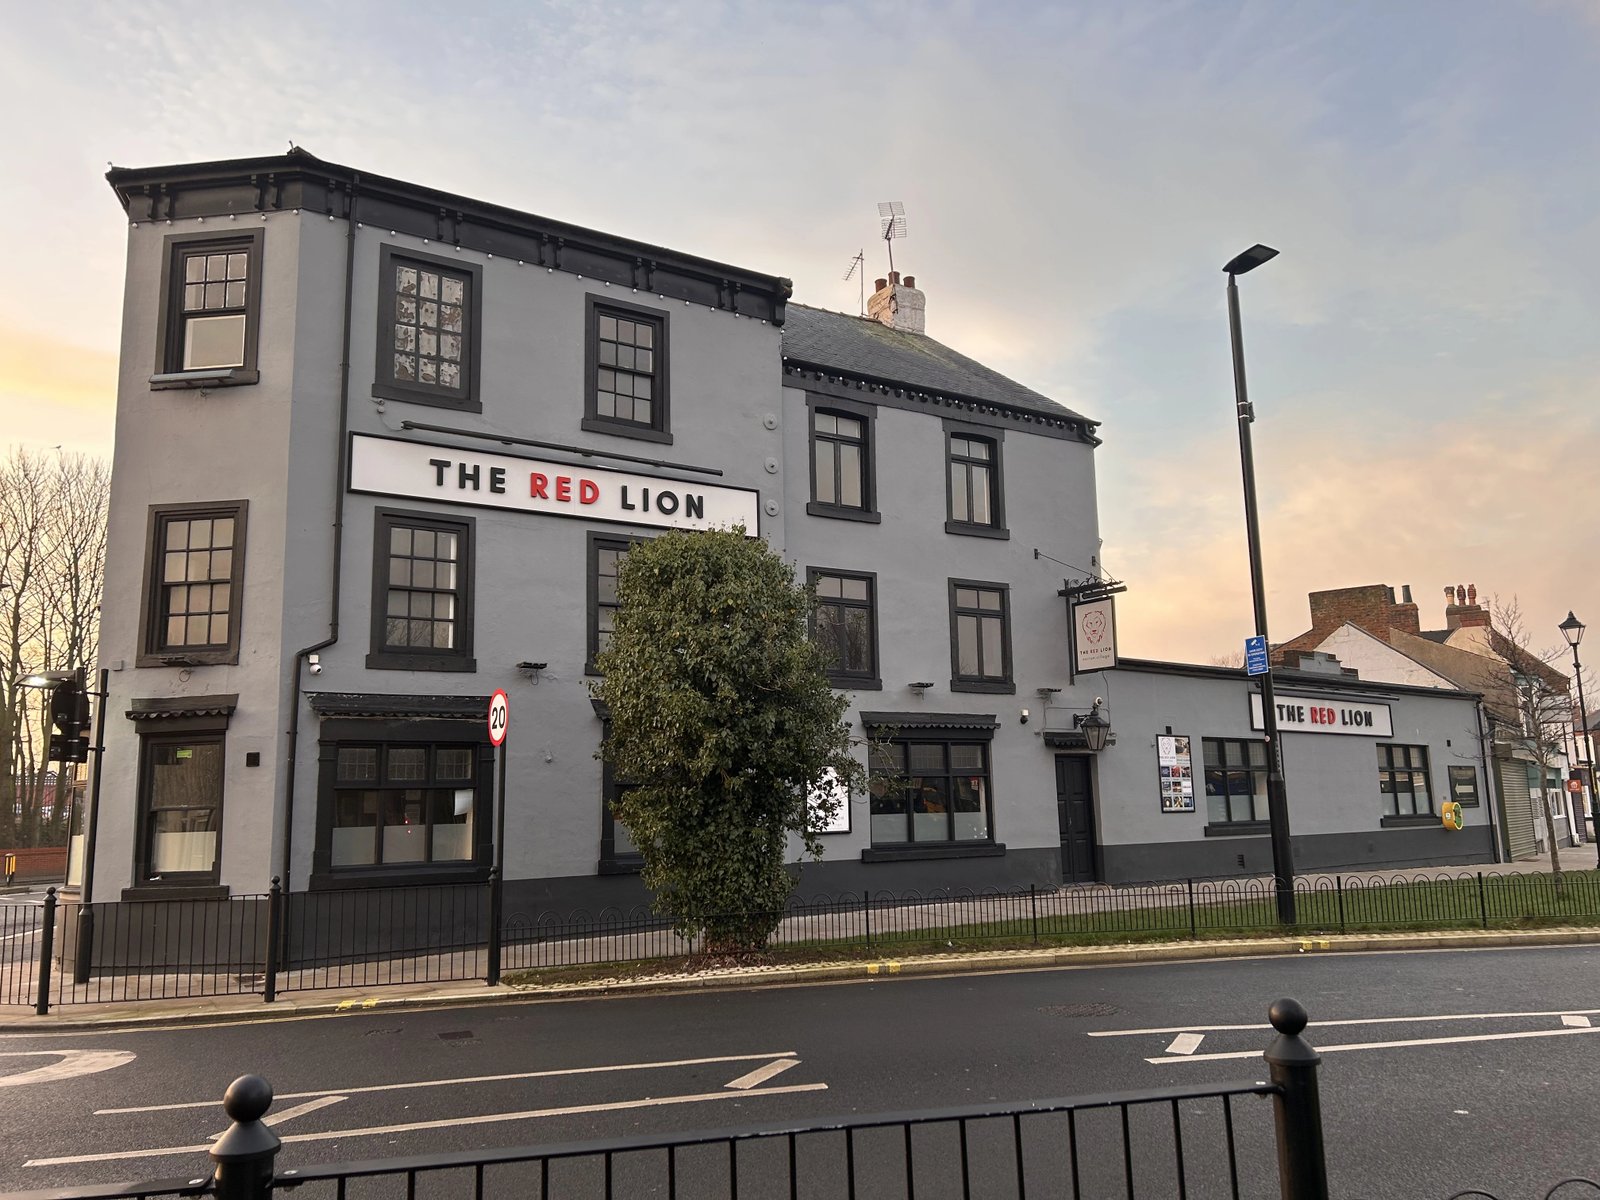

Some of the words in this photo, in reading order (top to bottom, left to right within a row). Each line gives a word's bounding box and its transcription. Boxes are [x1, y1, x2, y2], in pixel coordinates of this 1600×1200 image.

[429, 459, 506, 494] THE
[530, 472, 600, 504] RED
[621, 485, 704, 519] LION
[491, 705, 506, 730] 20
[1276, 704, 1305, 723] THE
[1310, 706, 1336, 725] RED
[1341, 709, 1373, 727] LION
